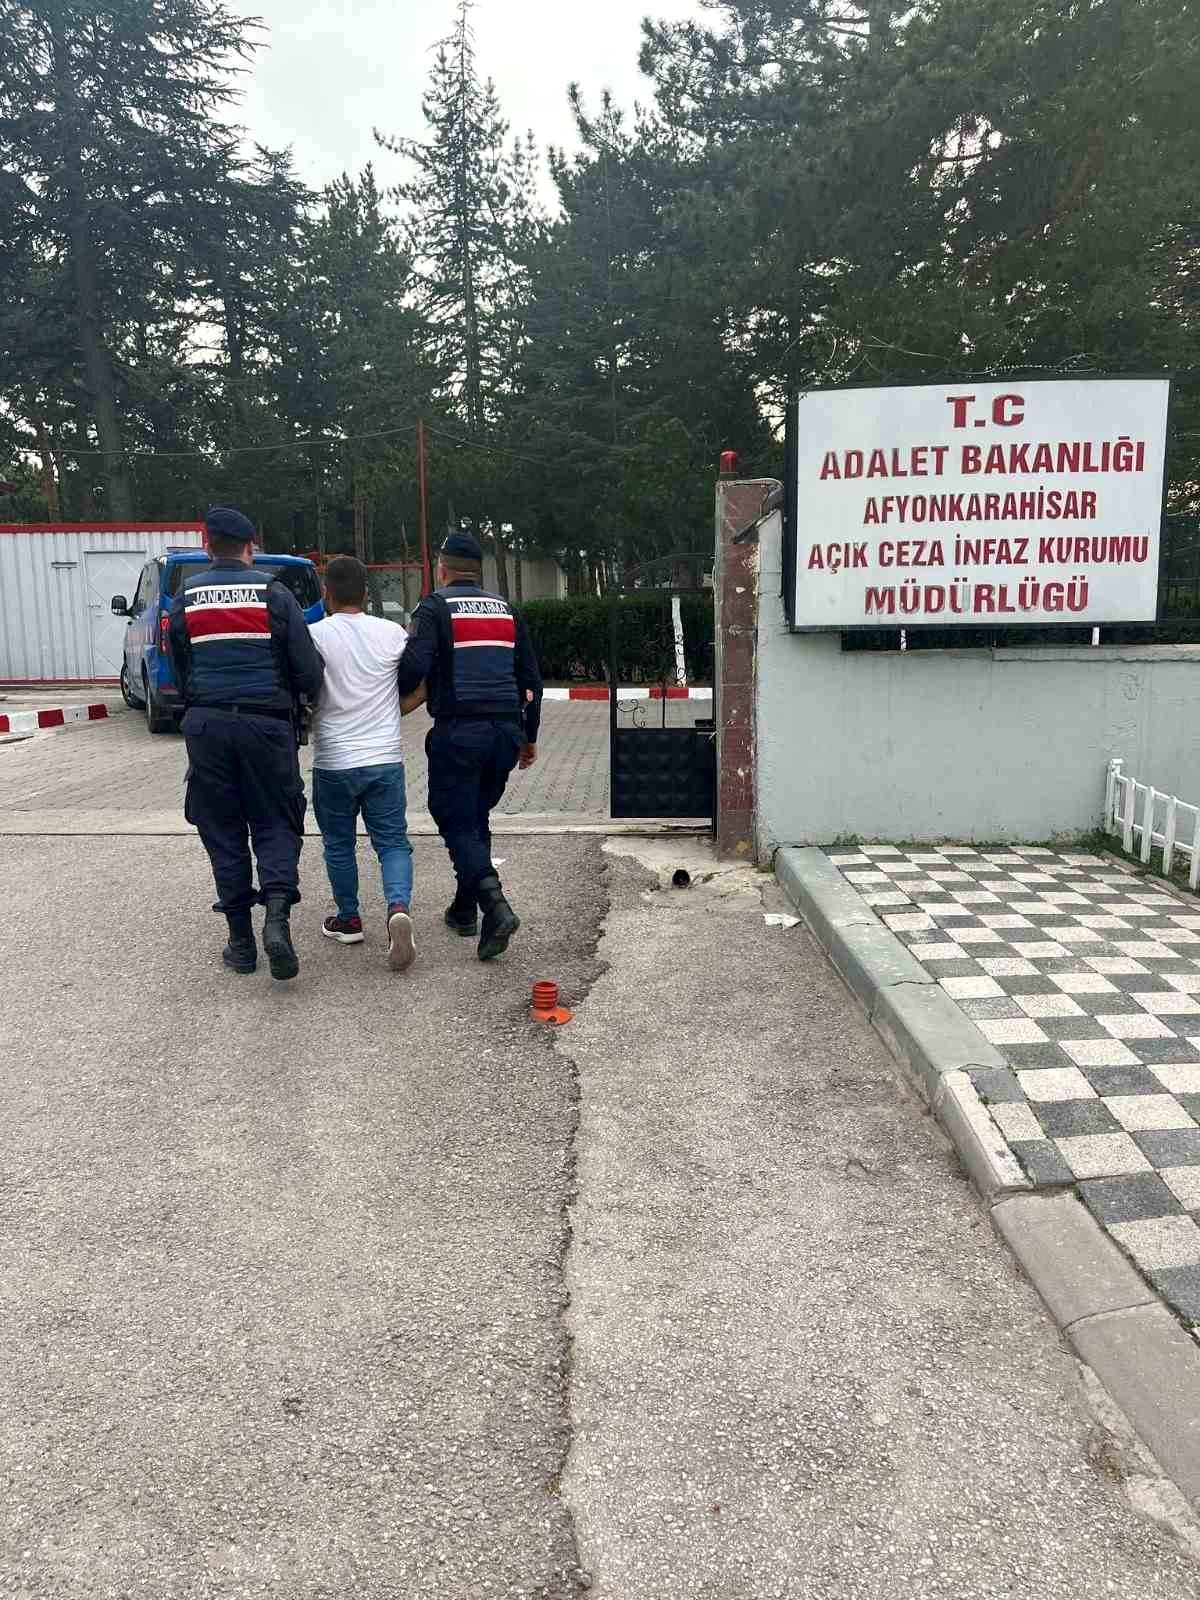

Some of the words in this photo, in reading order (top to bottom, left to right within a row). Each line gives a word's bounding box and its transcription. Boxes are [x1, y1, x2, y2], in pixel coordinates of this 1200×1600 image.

[946, 394, 1025, 428] T.C
[819, 445, 949, 480] ADALET
[960, 436, 1145, 475] BAKANLIĞI
[863, 485, 1097, 525] AFYONKARAHİSAR
[807, 541, 868, 574] AÇIK
[878, 540, 944, 567] CEZA
[955, 534, 1029, 565] İNFAZ
[1038, 535, 1149, 564] KURUMU
[192, 589, 259, 605] JANDARMA
[456, 601, 507, 615] JANDARMA
